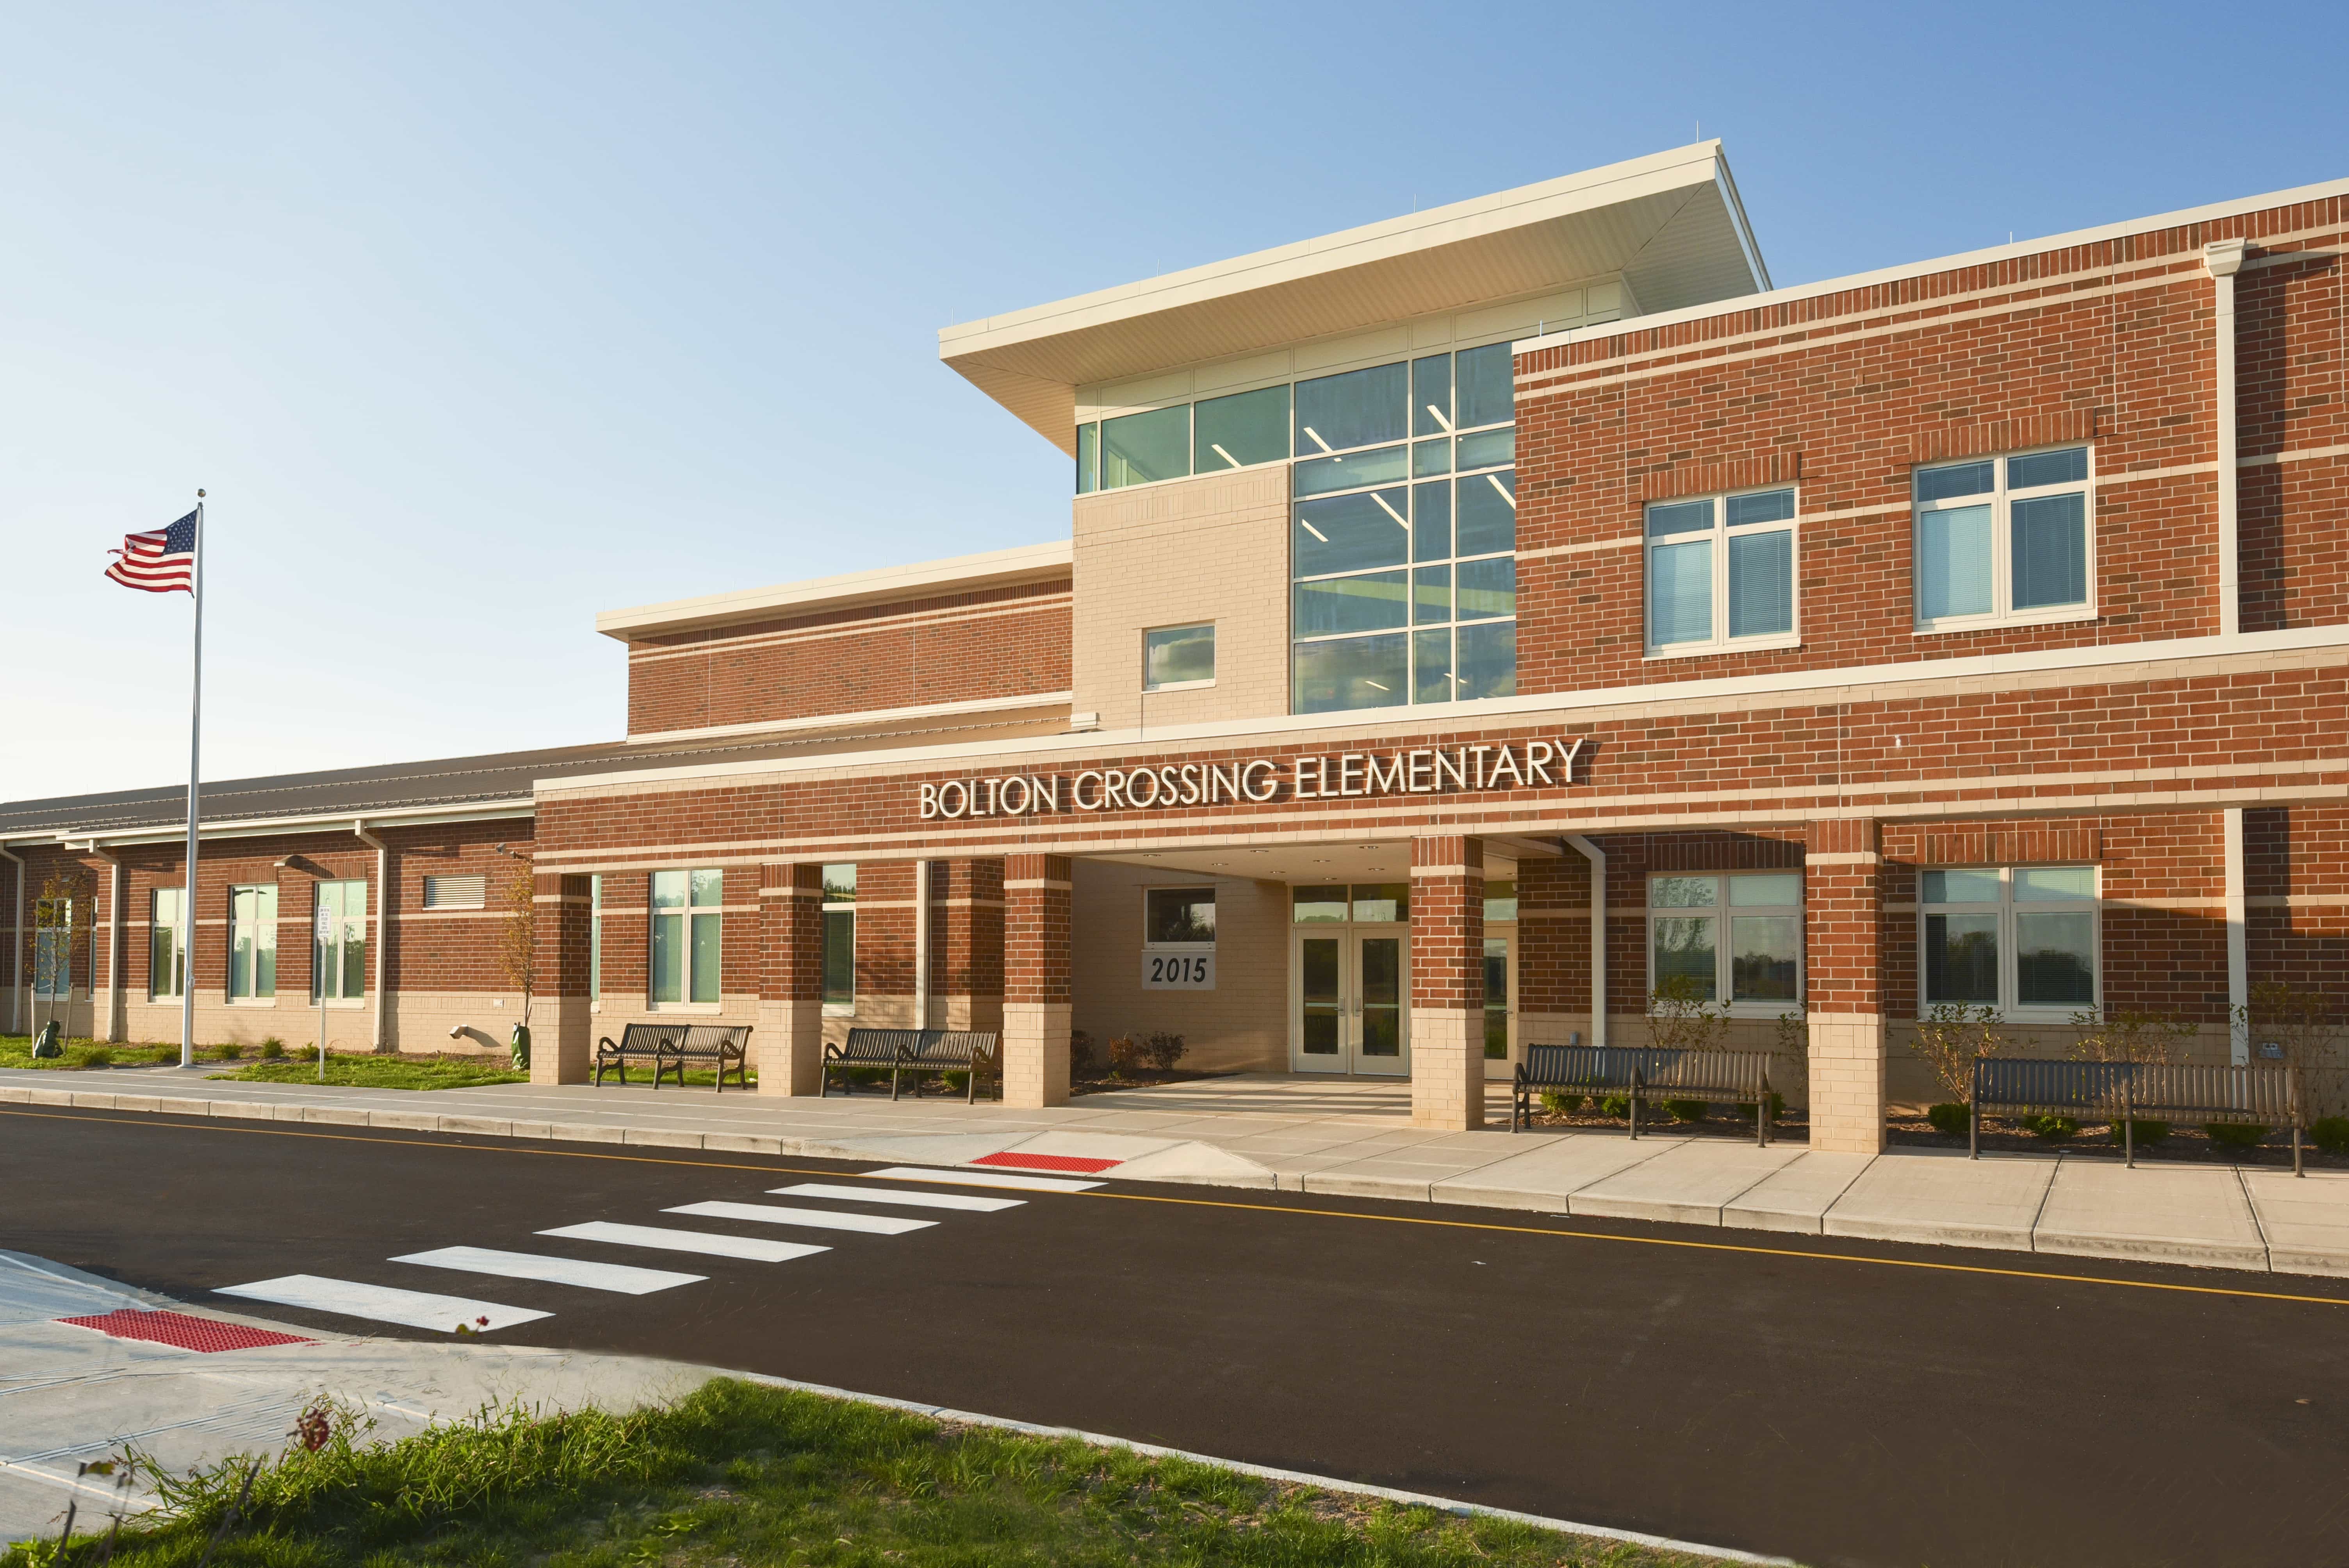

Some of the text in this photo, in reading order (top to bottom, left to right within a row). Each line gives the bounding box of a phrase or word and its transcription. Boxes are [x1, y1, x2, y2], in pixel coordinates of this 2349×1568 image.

[921, 738, 1583, 818] BOLTON CROSSING ELEMENTARY
[1151, 958, 1207, 982] 2015
